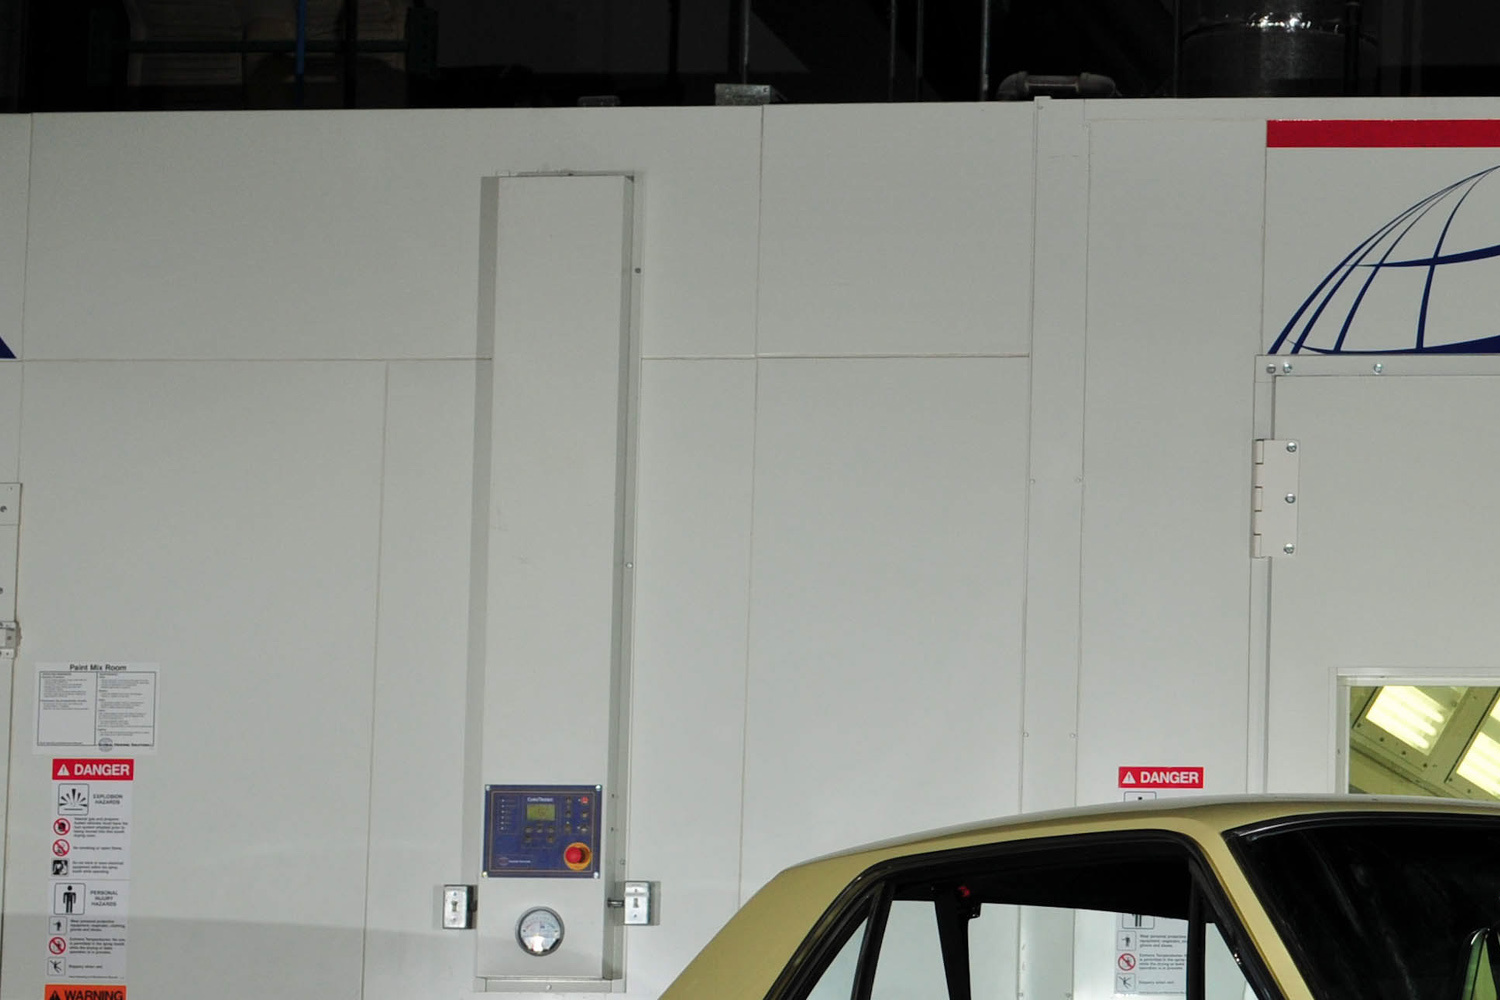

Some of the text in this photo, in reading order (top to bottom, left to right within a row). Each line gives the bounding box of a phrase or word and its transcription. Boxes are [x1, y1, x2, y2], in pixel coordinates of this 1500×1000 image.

[69, 663, 127, 671] Paint Mix Room
[74, 764, 130, 776] DANGER
[1140, 771, 1199, 784] DANGER
